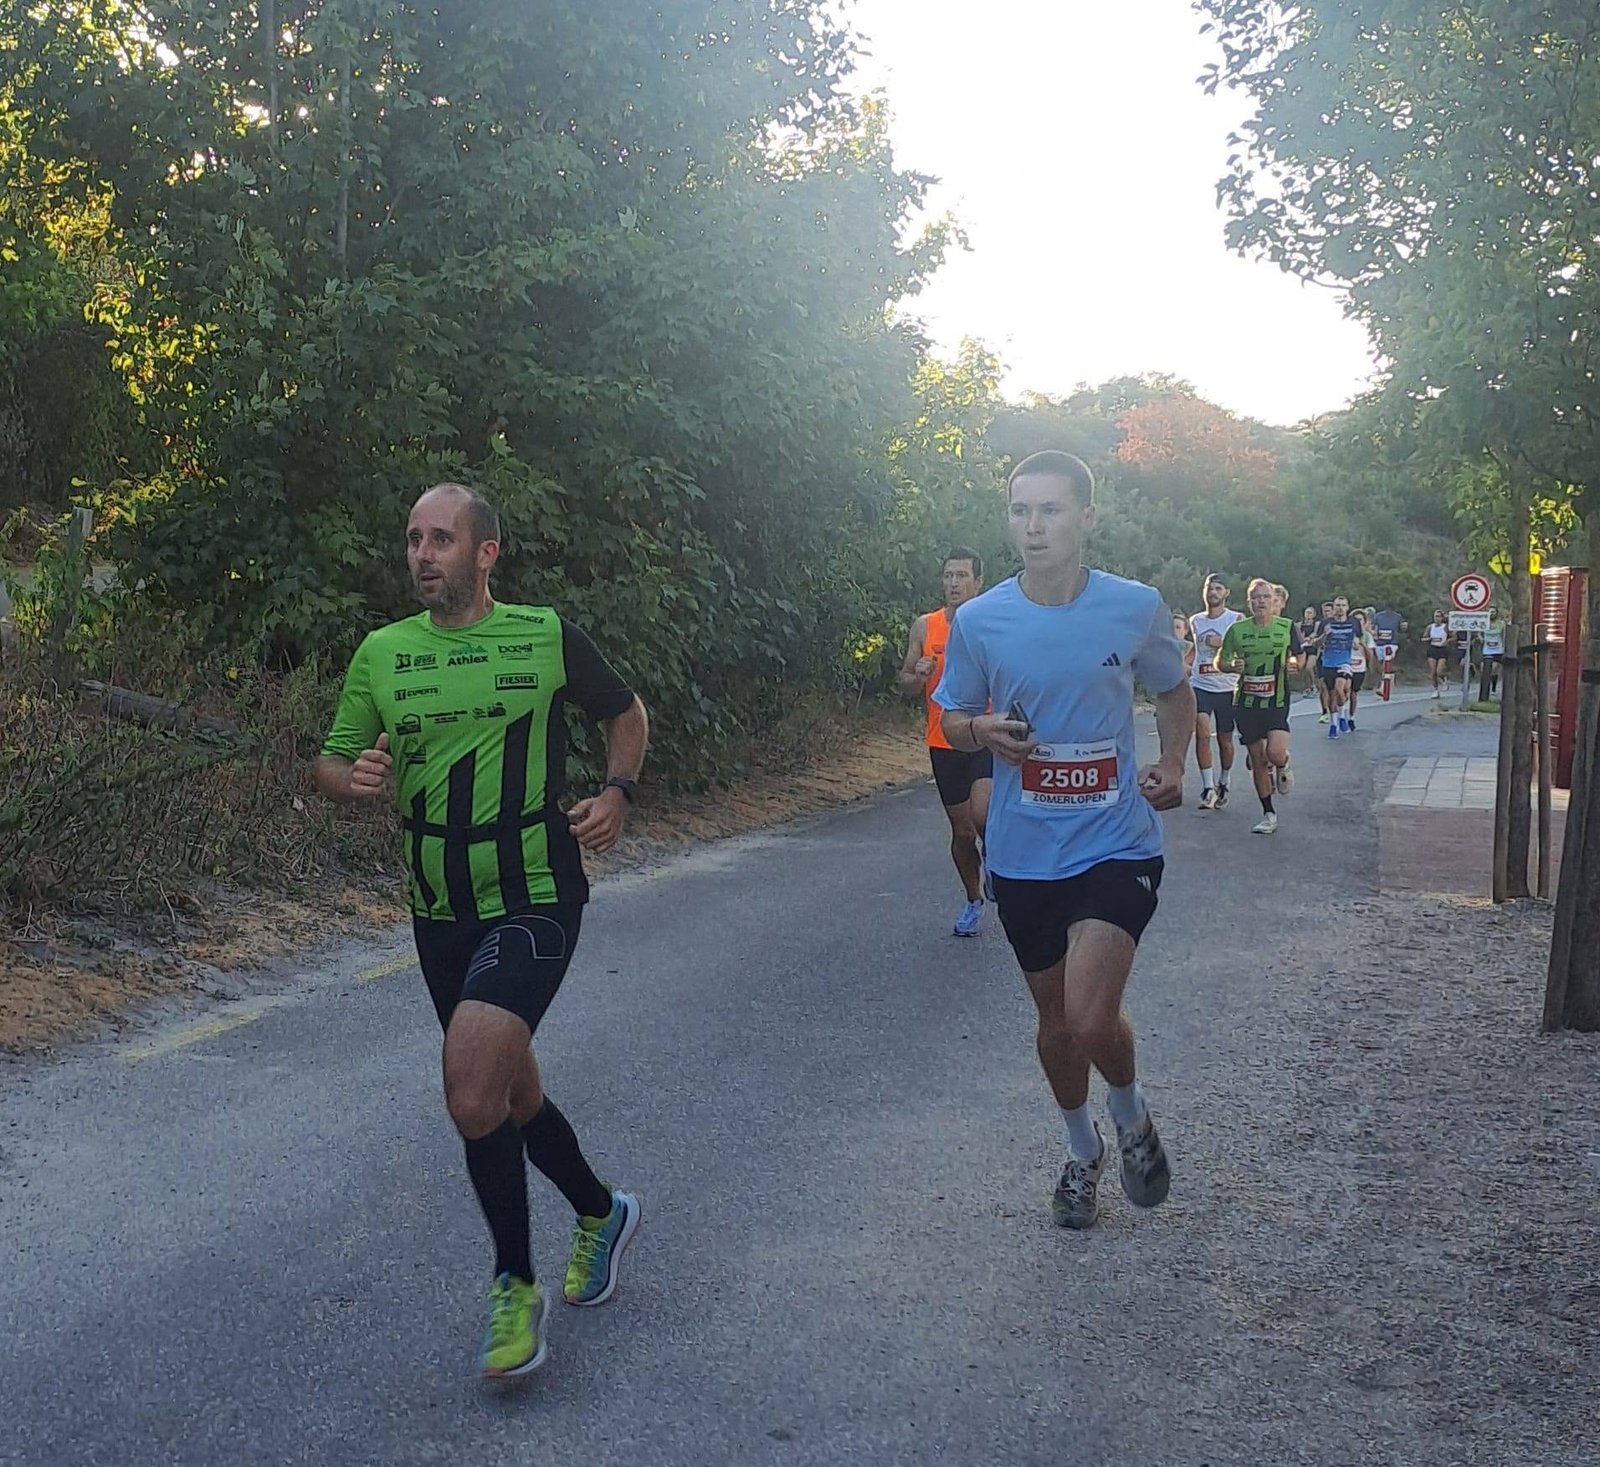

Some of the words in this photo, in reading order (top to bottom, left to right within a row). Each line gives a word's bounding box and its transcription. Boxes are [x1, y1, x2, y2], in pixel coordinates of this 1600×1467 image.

[447, 655, 489, 667] Athlex
[1040, 767, 1099, 788] 2508
[1033, 793, 1107, 805] ZOMERLOPEN
